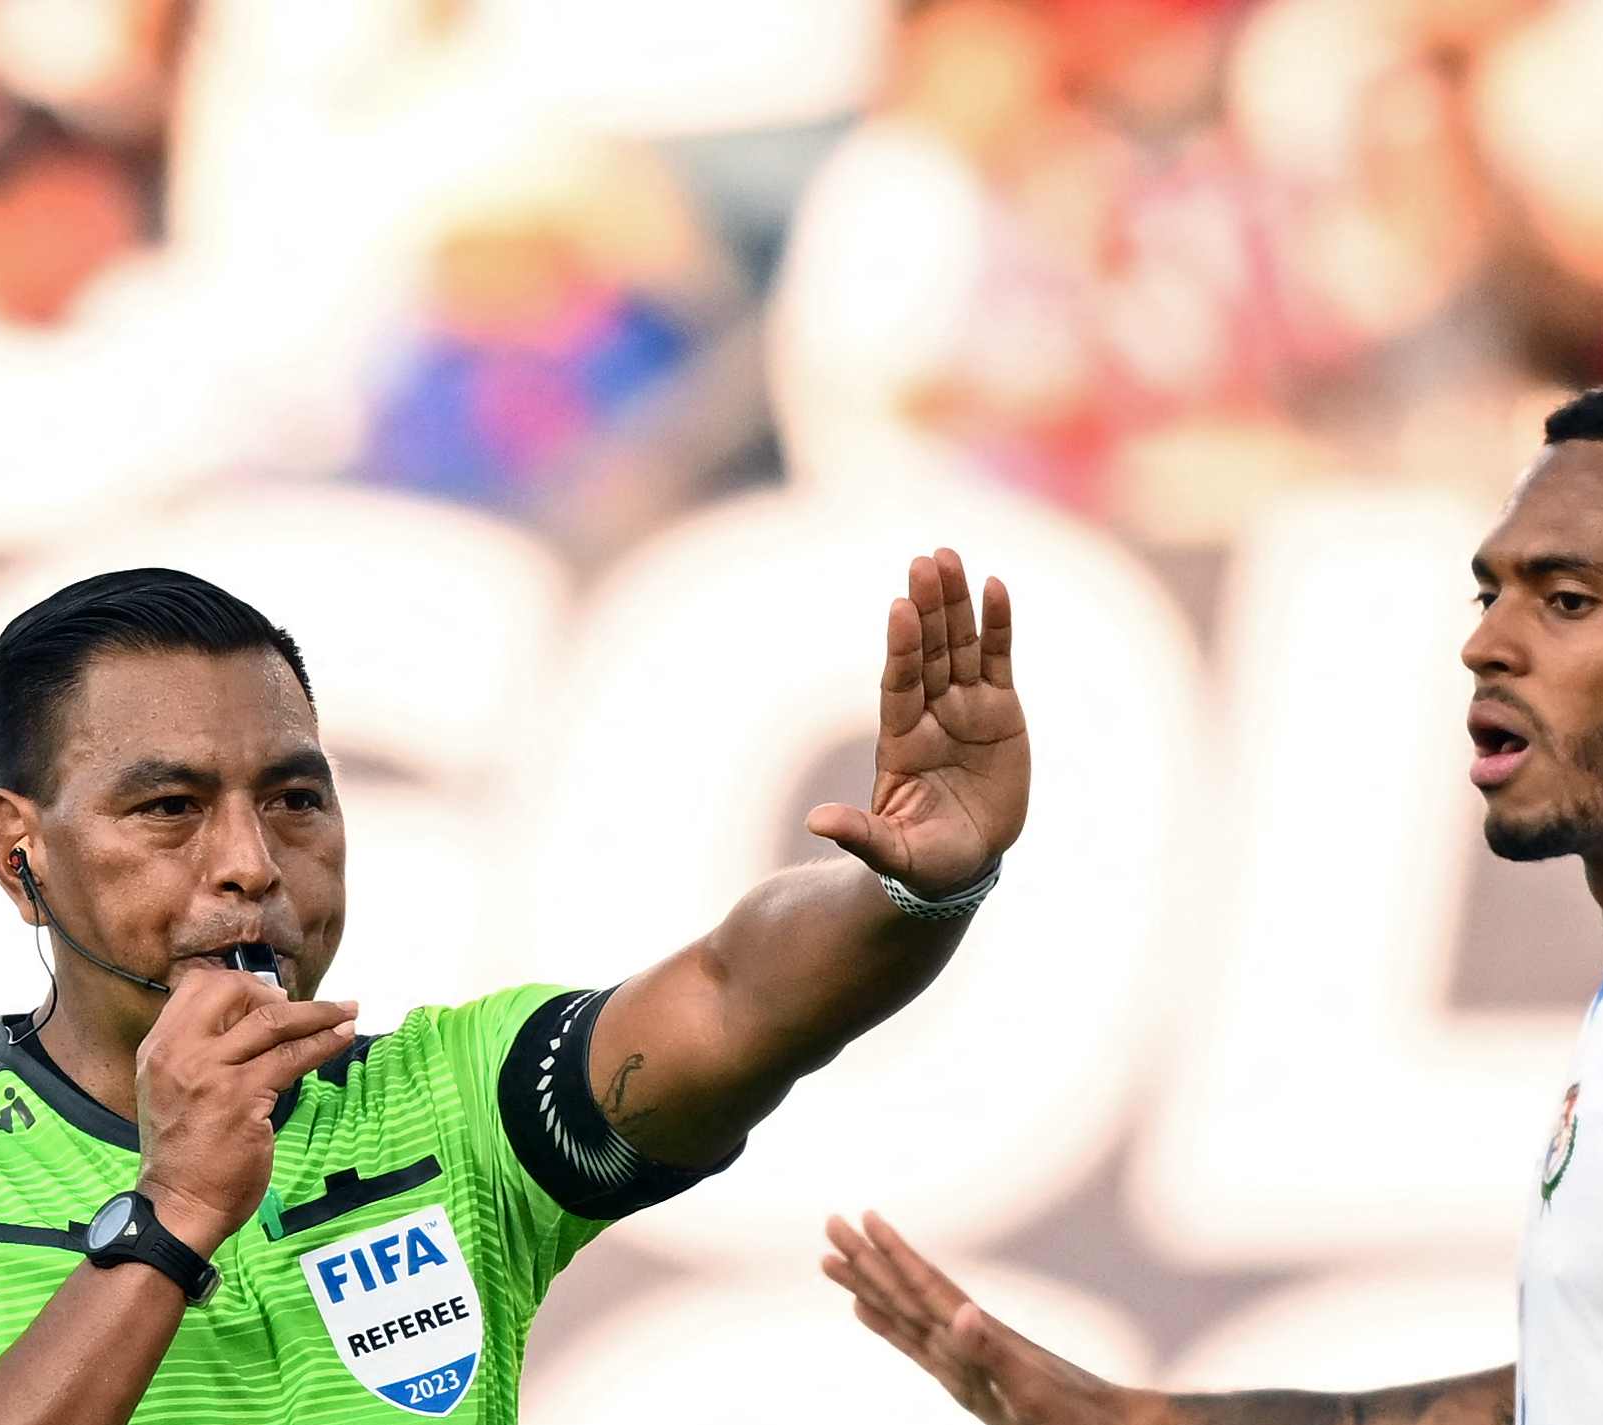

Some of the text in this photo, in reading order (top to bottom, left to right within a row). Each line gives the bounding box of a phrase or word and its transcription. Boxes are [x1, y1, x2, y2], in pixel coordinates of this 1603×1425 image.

[316, 1226, 449, 1305] FIFA
[347, 1296, 470, 1358] REFEREE
[404, 1368, 461, 1405] 2023
